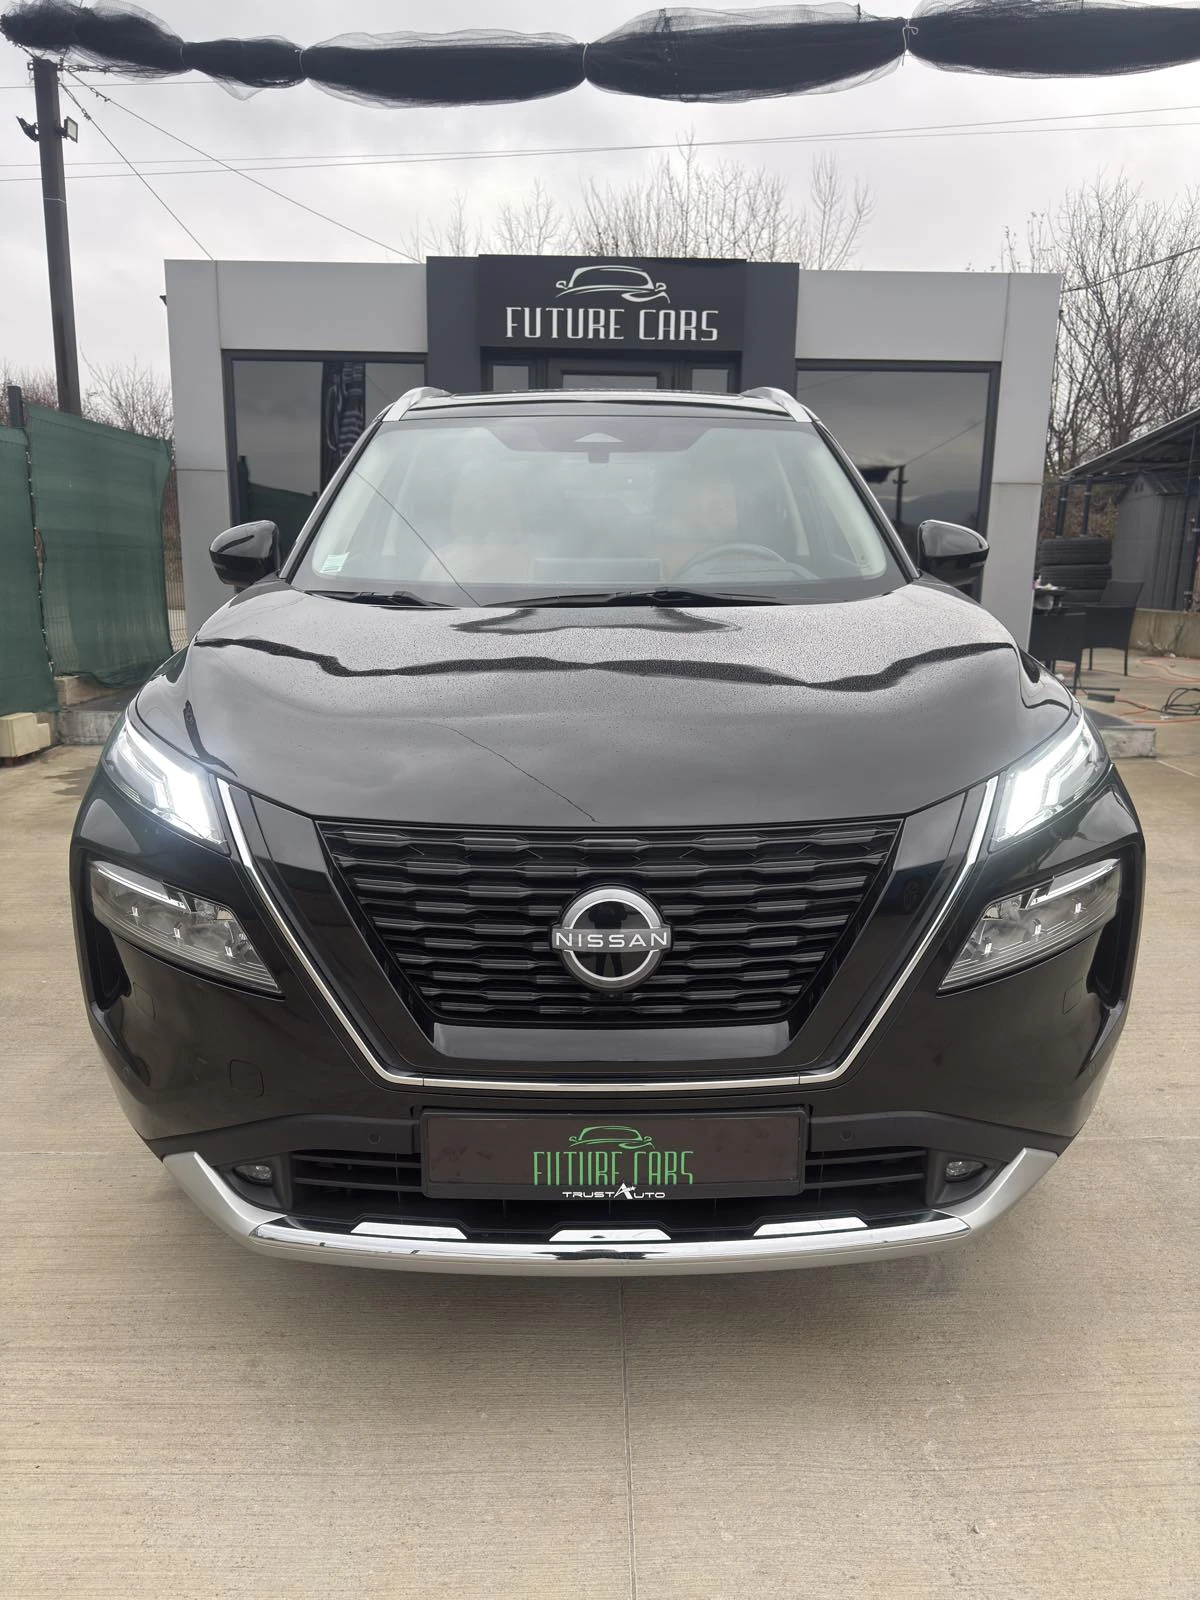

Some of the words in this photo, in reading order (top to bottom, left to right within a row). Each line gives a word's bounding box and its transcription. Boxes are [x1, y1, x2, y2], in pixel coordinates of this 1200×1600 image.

[505, 306, 625, 340] FUTURE
[638, 309, 719, 341] CARS
[555, 931, 667, 948] NISSAN
[533, 1151, 623, 1186] FUTURE
[633, 1151, 694, 1186] CARS
